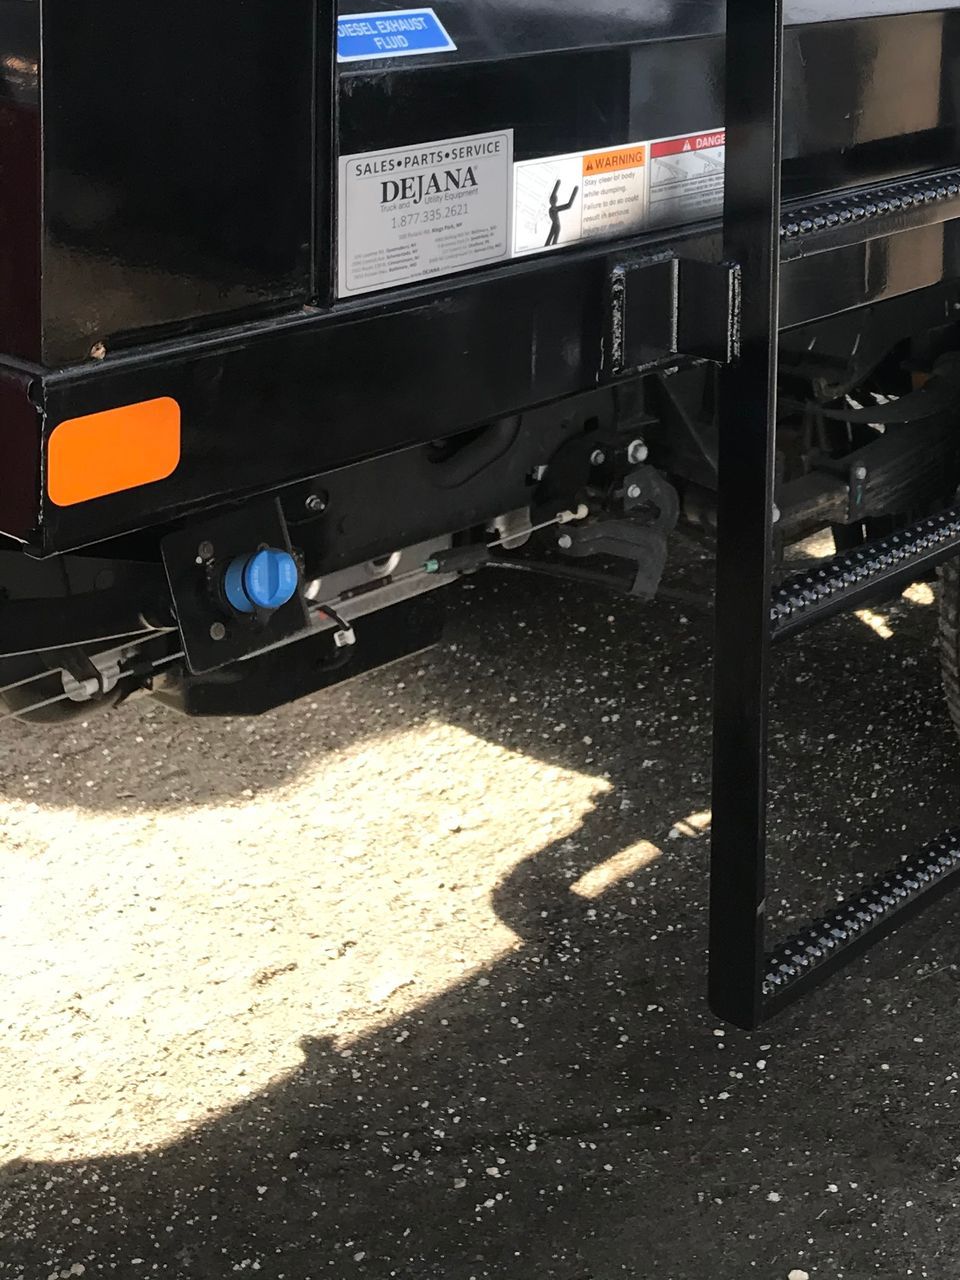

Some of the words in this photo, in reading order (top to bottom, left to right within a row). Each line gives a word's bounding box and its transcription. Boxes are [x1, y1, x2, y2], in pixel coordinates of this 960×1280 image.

[376, 17, 428, 34] EXHAUST
[373, 35, 409, 50] FLUID
[695, 133, 726, 149] DANGE
[355, 159, 395, 177] SALES
[404, 150, 443, 168] PARTS
[451, 141, 501, 160] SERVICE
[595, 151, 643, 169] WARNING
[380, 166, 479, 205] DEJANA
[380, 204, 397, 213] Truck
[398, 201, 411, 210] and
[424, 195, 444, 206] Utility
[444, 187, 479, 202] Equipment
[391, 203, 469, 229] 1.877.335.2621
